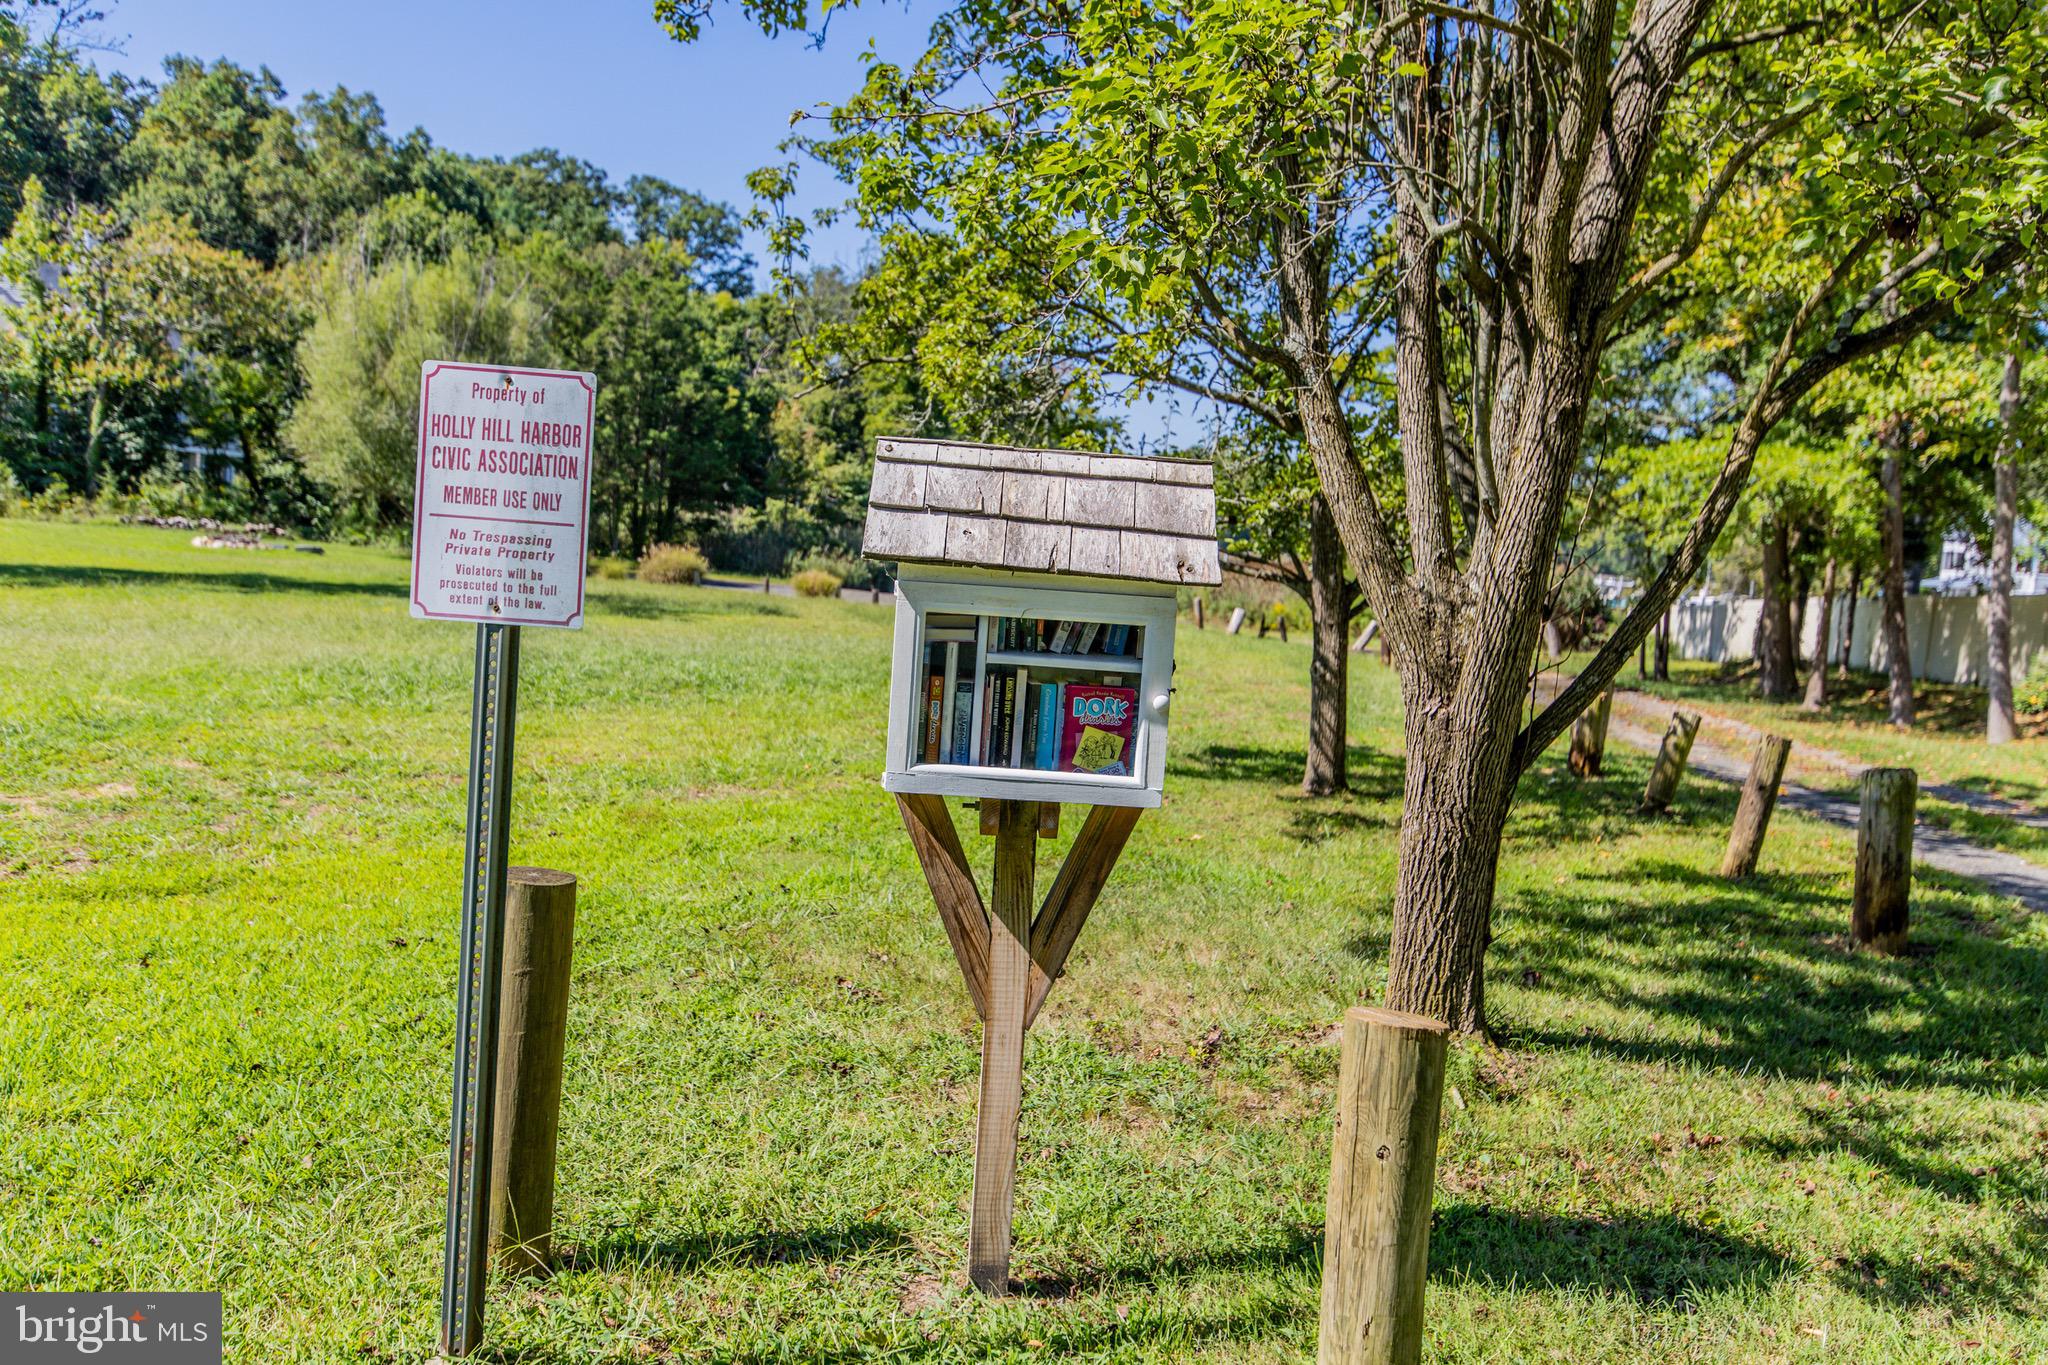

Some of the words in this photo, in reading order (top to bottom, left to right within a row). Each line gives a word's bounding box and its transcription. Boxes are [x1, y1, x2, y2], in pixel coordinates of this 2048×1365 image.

[472, 382, 526, 406] Property
[533, 388, 545, 404] of
[432, 414, 476, 439] HOLLY
[482, 418, 514, 442] HILL
[521, 421, 581, 448] HARBOR
[432, 446, 470, 471] CIVIC
[478, 448, 578, 480] ASSOCIATION
[444, 485, 497, 506] MEMBER
[504, 490, 527, 509] USE
[533, 492, 562, 512] ONLY
[450, 529, 466, 540] No
[473, 530, 552, 548] Trespassing
[445, 543, 490, 556] Private
[498, 547, 554, 563] Property
[456, 564, 502, 578] Violators
[508, 568, 526, 579] will
[531, 569, 542, 581] be
[440, 580, 497, 592] prosecuted
[504, 582, 512, 592] to
[518, 583, 534, 594] the
[540, 584, 556, 596] full
[450, 594, 482, 604] extent
[488, 596, 498, 606] of
[504, 596, 519, 608] the
[525, 598, 545, 610] law.
[1072, 696, 1130, 720] DORK
